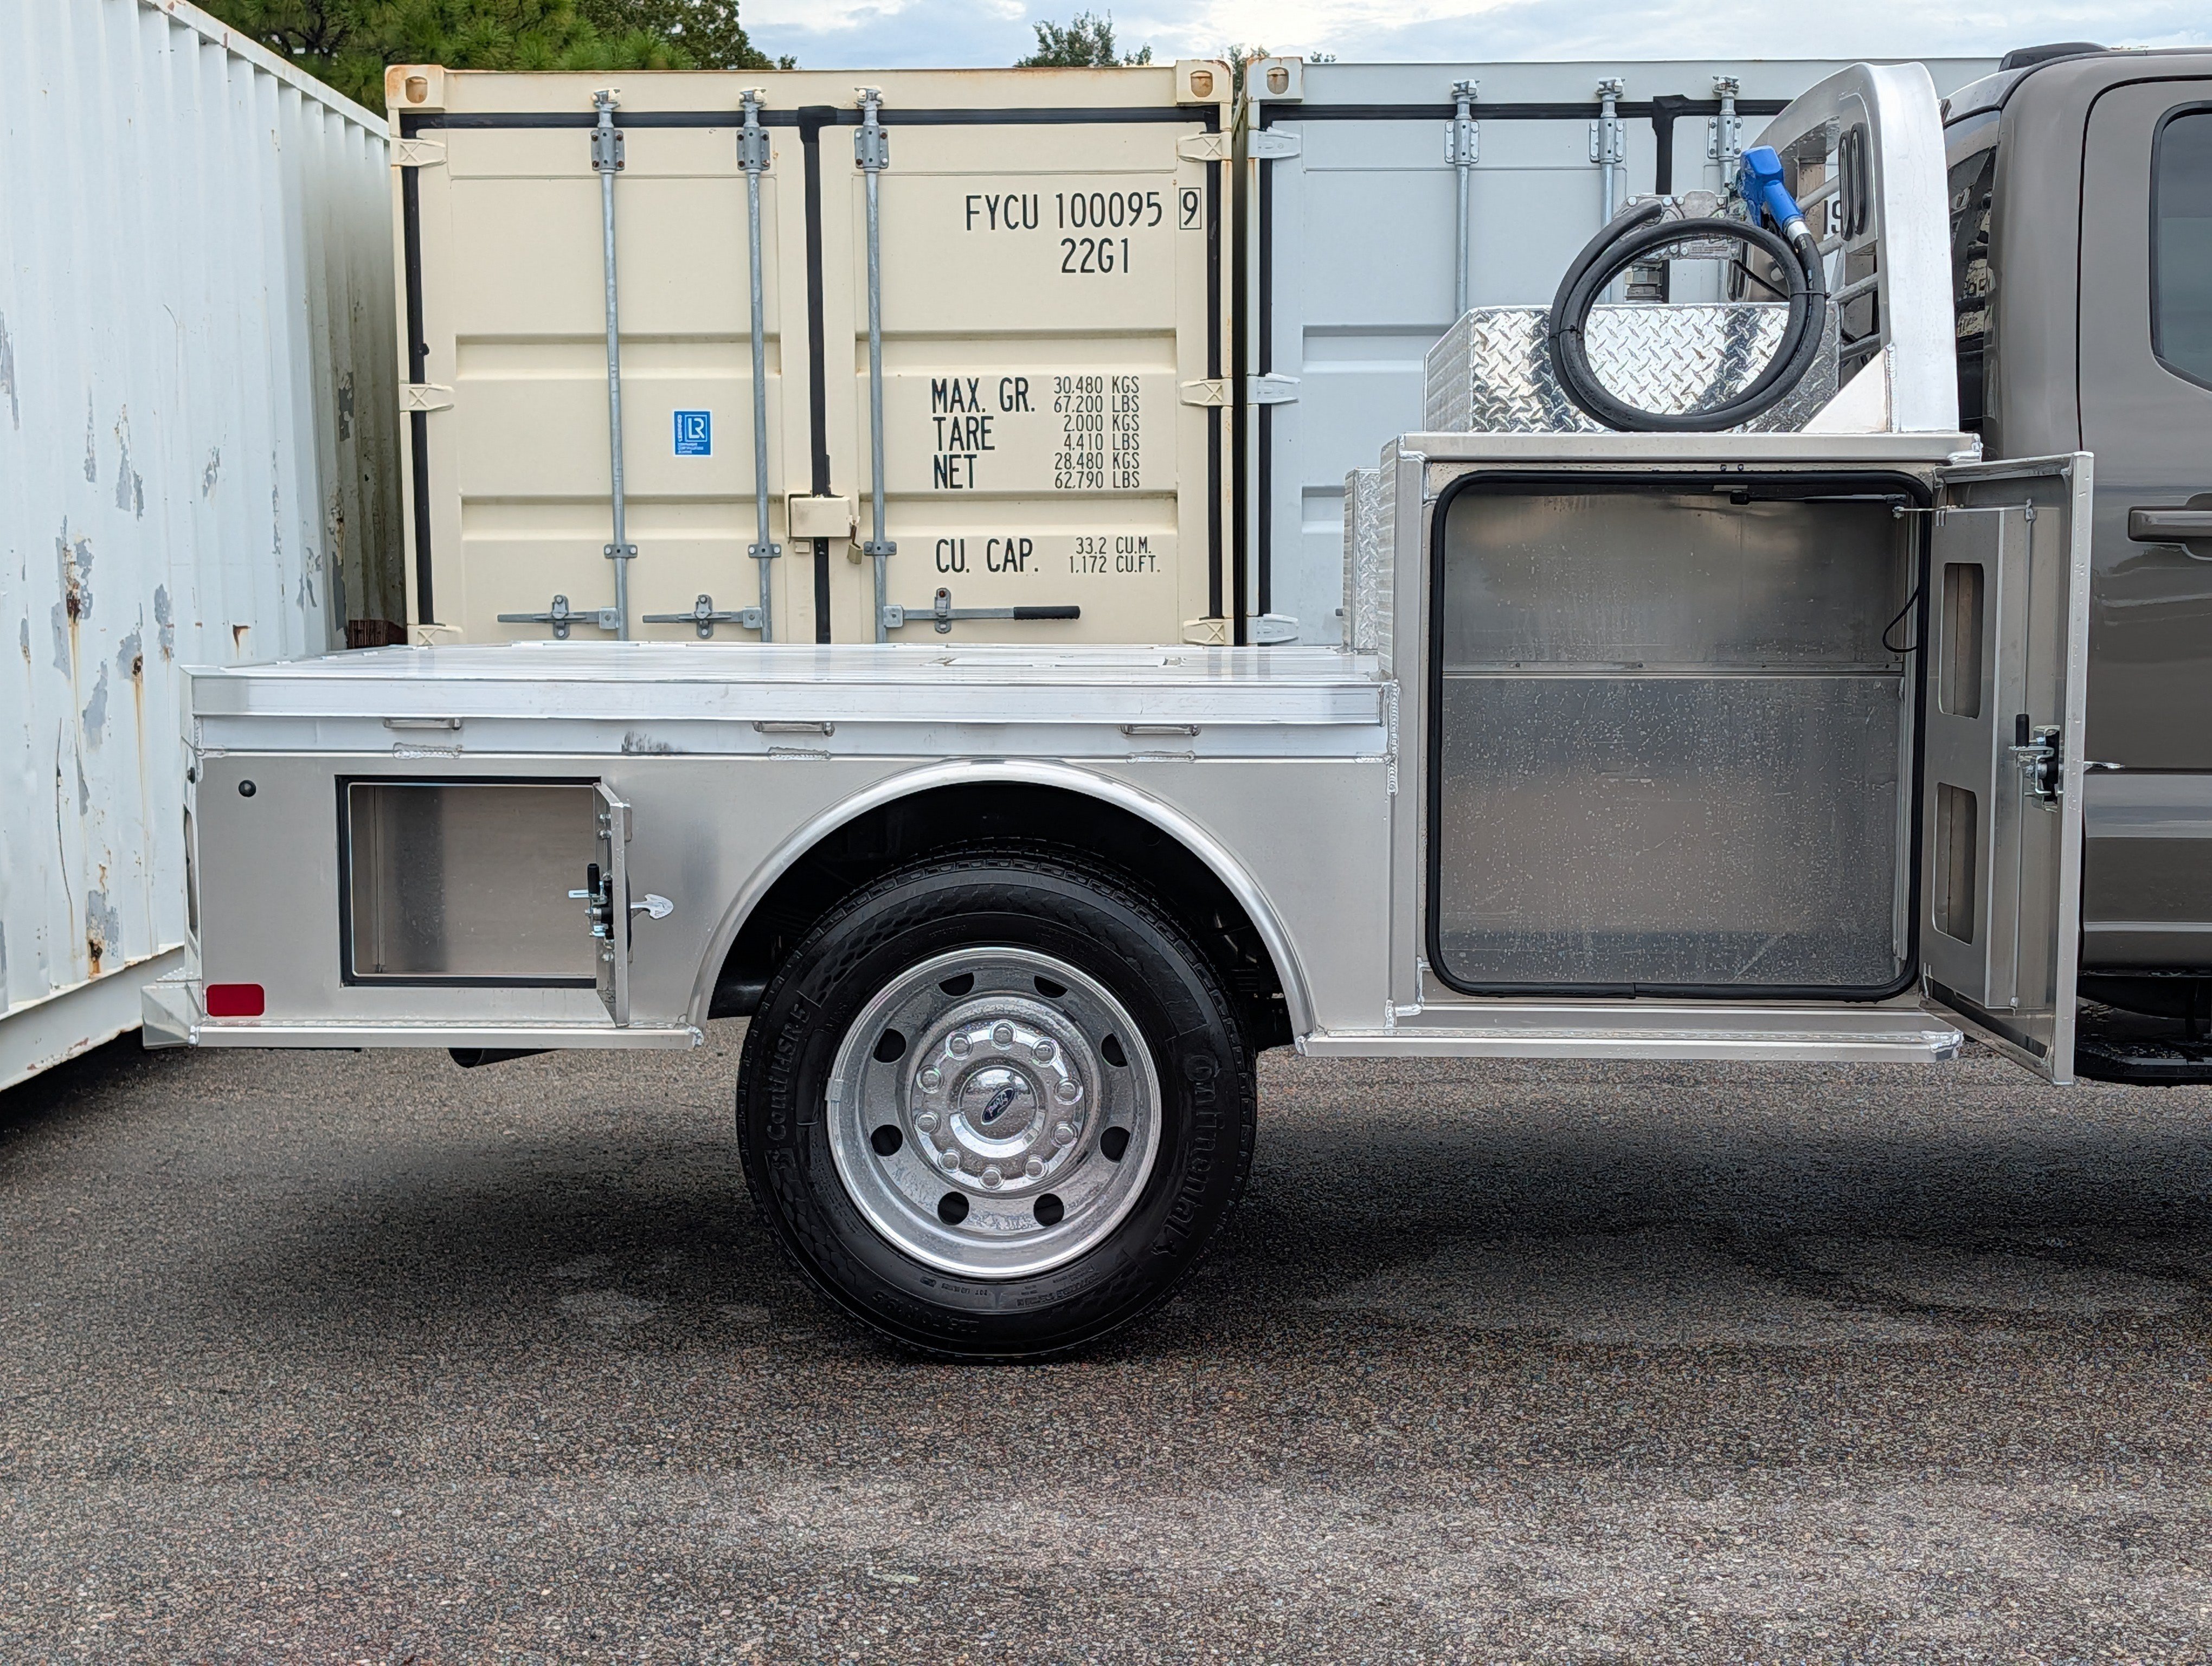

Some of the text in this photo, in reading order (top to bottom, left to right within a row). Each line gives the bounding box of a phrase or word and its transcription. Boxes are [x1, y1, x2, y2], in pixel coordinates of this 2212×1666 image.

[966, 190, 1198, 231] FYCU 100095 9
[1060, 238, 1128, 273] 22G1
[1112, 376, 1139, 394] KGS
[931, 377, 1035, 414] MAX. GR.
[1112, 394, 1140, 413] LBS
[688, 418, 705, 439] LR
[1112, 414, 1140, 432] KGS
[933, 415, 995, 452] TARE
[1113, 433, 1140, 451] LBS
[1113, 452, 1140, 470] KGS
[934, 454, 978, 489] NET
[1113, 471, 1140, 489] LBS
[1076, 536, 1152, 555] 33.2 CU.M.
[936, 538, 1039, 573] CU. CAP.
[1116, 555, 1160, 573] CU.FT.
